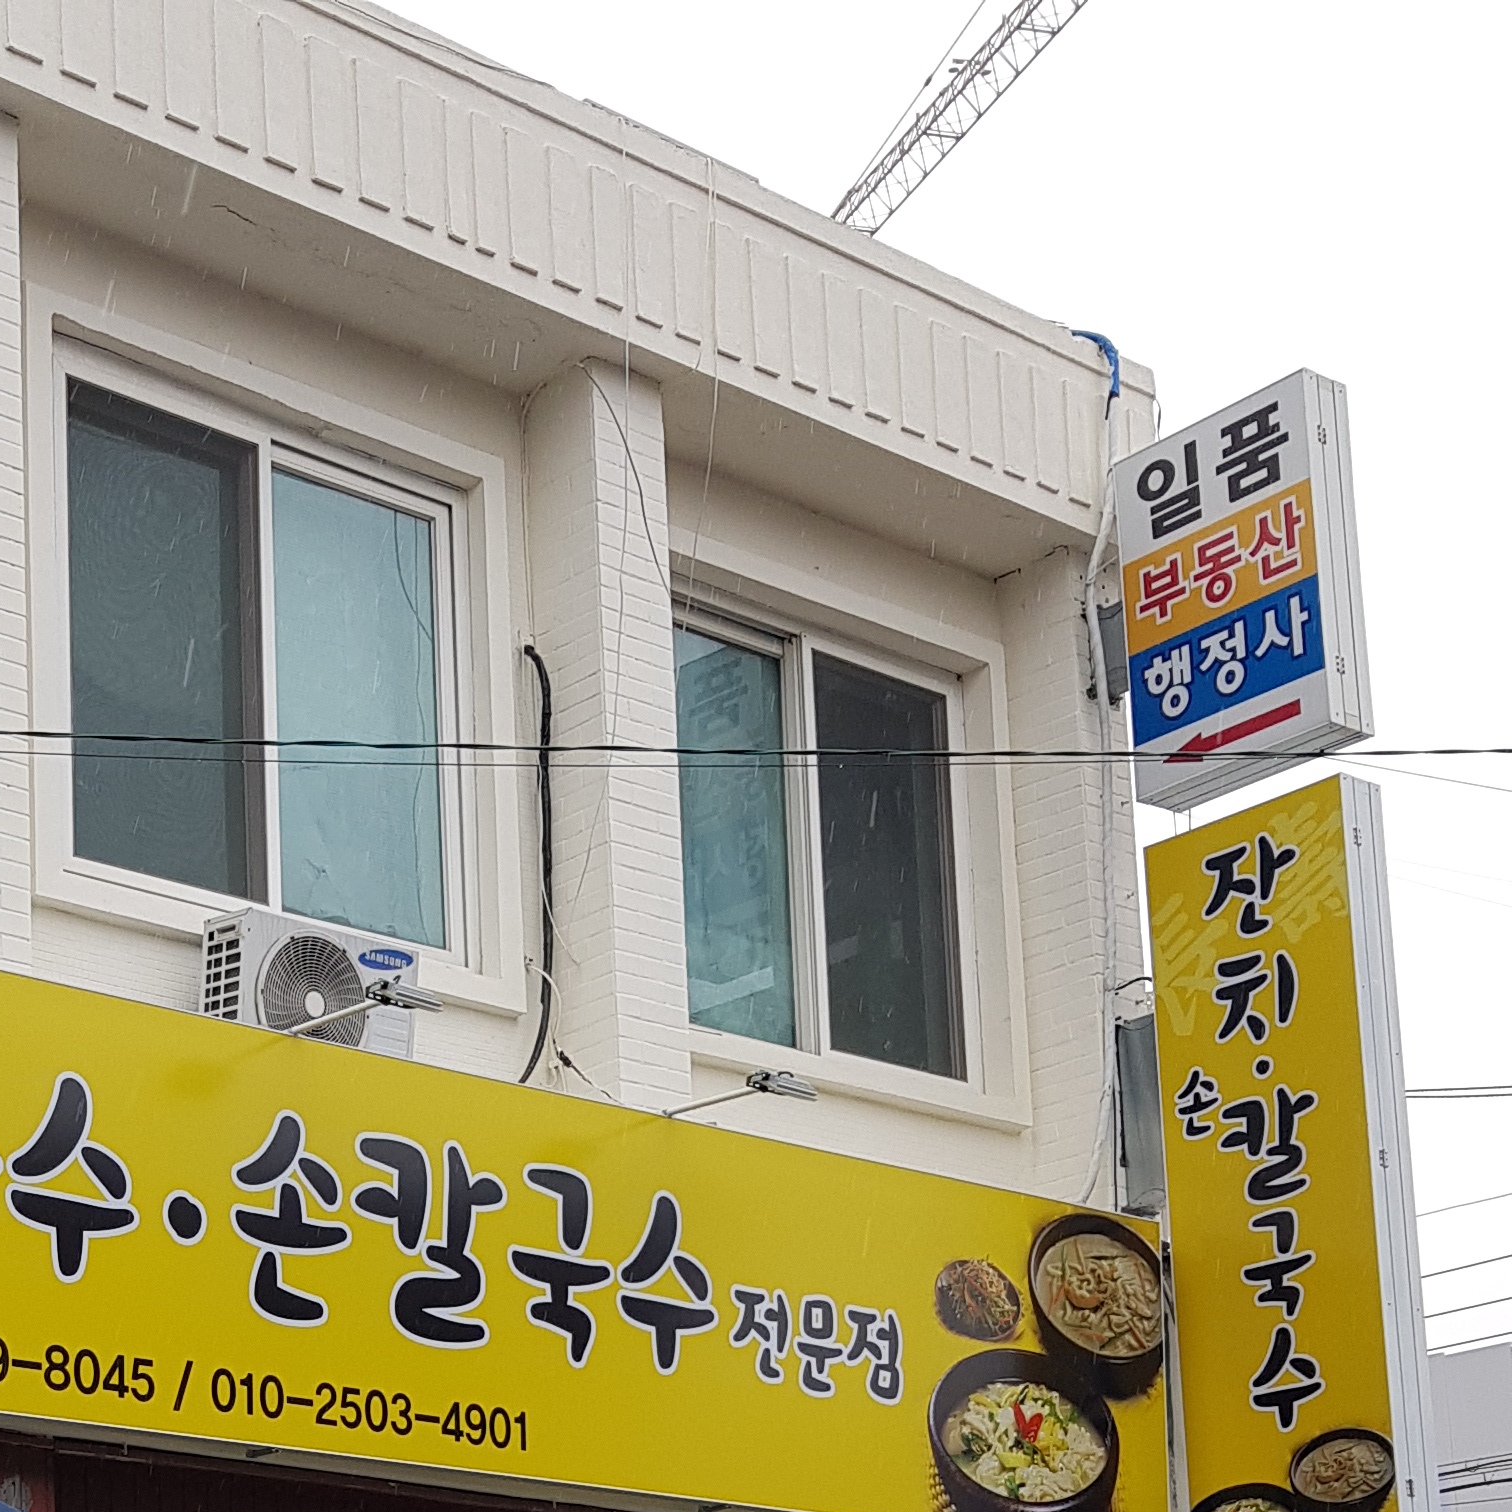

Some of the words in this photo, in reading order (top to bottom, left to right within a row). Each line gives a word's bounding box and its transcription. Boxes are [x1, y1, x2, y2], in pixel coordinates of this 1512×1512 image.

[1136, 400, 1289, 541] 일품
[1136, 495, 1307, 624] 부동산
[1143, 592, 1309, 719] 행정사
[364, 950, 408, 969] SAMSUNG
[729, 1283, 905, 1404] 전문점
[210, 1367, 529, 1452] 010-2503-4901
